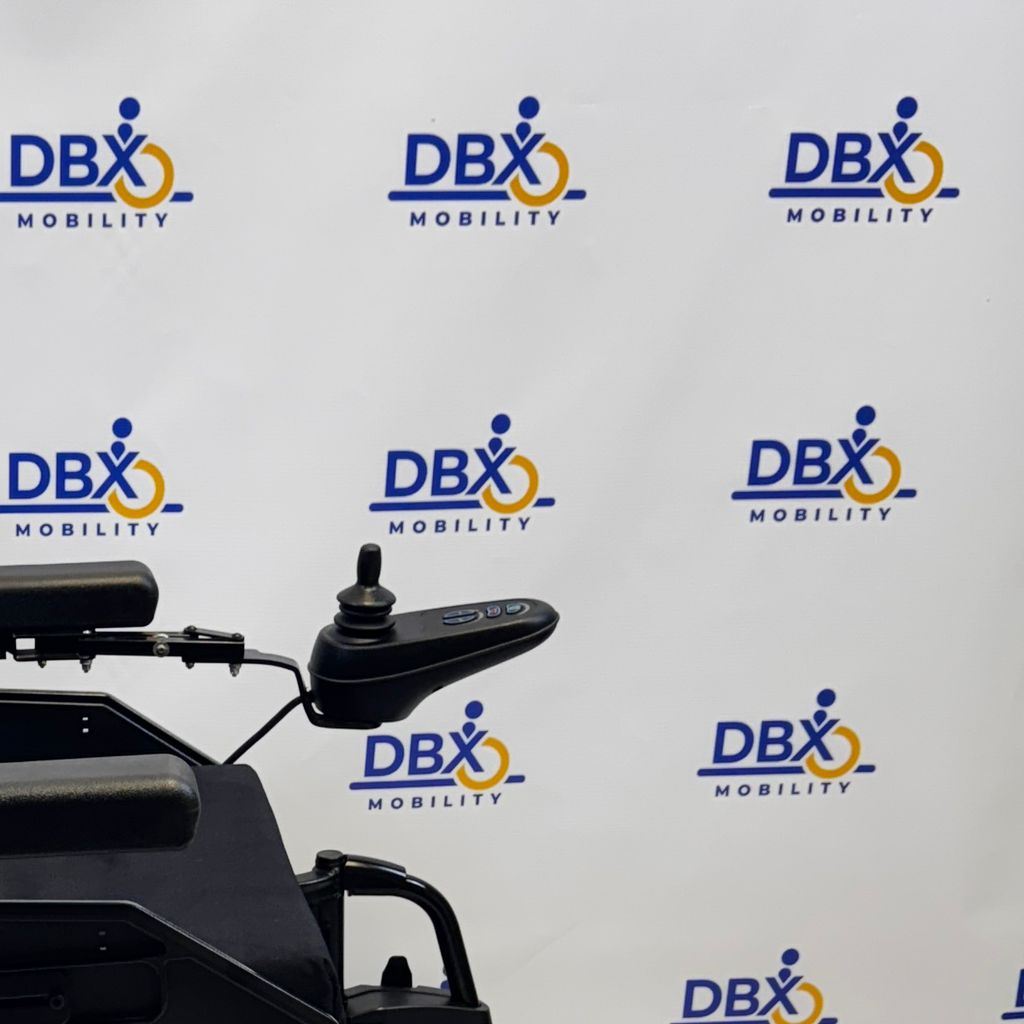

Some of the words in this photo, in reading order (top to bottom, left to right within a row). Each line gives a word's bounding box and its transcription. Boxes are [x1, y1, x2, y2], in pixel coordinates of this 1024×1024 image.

[11, 135, 147, 187] DBX
[405, 134, 545, 185] DBX
[785, 133, 922, 183] DBX
[18, 213, 167, 228] MOBILITY
[411, 211, 559, 226] MOBILITY
[787, 208, 932, 222] MOBILITY
[9, 452, 139, 499] DBX
[385, 448, 516, 497] DBX
[747, 439, 879, 486] DBX
[16, 523, 158, 536] MOBILITY
[390, 518, 529, 534] MOBILITY
[750, 508, 890, 522] MOBILITY
[364, 731, 488, 777] DBX
[713, 719, 840, 764] DBX
[369, 793, 501, 810] MOBILITY
[716, 782, 850, 796] MOBILITY
[683, 976, 803, 1018] DBX
